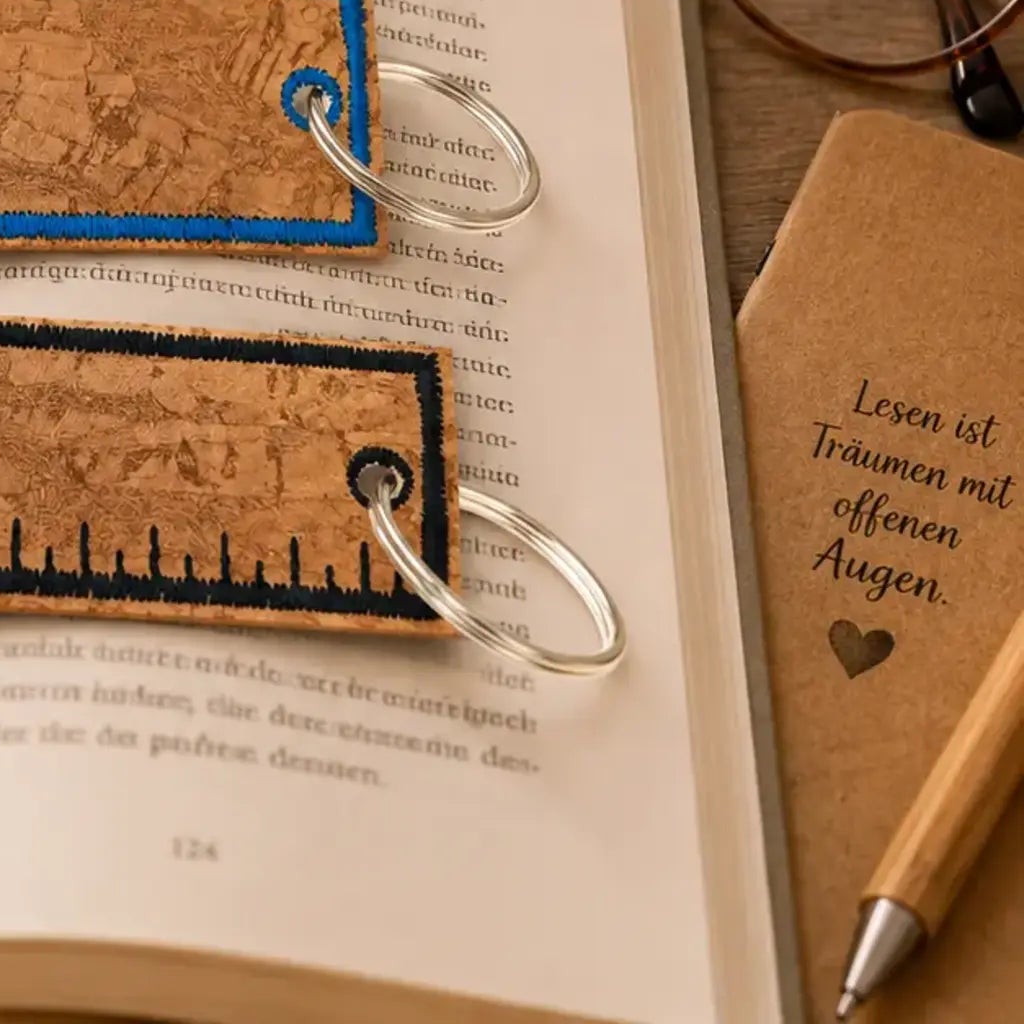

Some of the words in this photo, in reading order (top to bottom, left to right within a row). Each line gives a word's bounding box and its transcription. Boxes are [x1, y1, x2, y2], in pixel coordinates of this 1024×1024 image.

[853, 378, 946, 434] Lesen
[954, 412, 1001, 449] ist
[813, 421, 949, 491] Träumen
[956, 474, 1017, 510] mit
[833, 488, 963, 551] offenen
[812, 536, 948, 605] Augen.
